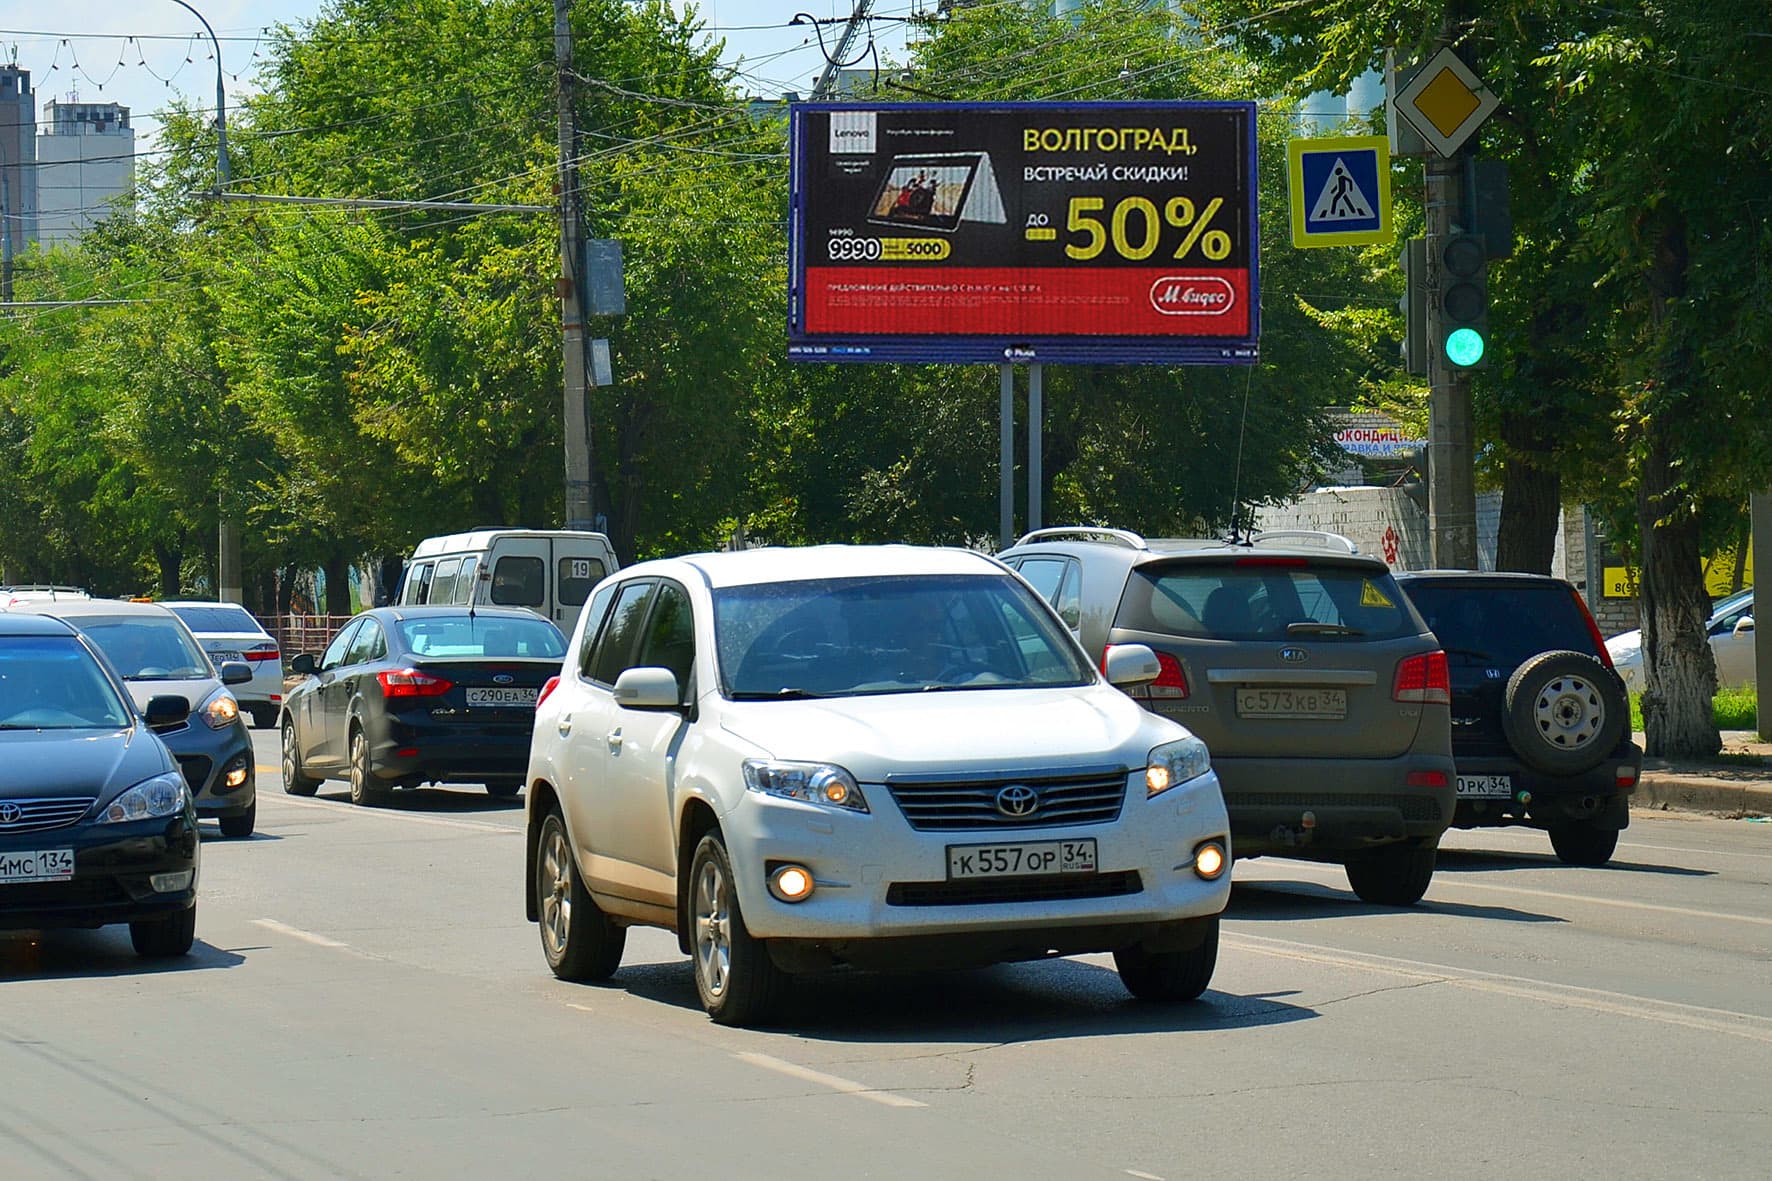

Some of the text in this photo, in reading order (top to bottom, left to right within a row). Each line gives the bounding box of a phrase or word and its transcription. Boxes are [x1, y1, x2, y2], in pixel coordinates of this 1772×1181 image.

[835, 129, 869, 138] Lenovo
[1024, 128, 1198, 155] ВОЛГОГРАД,
[1024, 163, 1188, 183] ВСТРЕЧАЙ СКИДКИ!
[828, 238, 880, 260] 9990
[907, 243, 942, 255] 5000
[1337, 430, 1408, 442] ОКОНДИЦ
[574, 562, 588, 576] 19
[1282, 650, 1305, 660] KIA
[522, 689, 535, 698] 34
[1322, 691, 1340, 705] 34
[1490, 776, 1505, 790] 34
[39, 852, 72, 868] 134
[1063, 844, 1087, 862] 34
